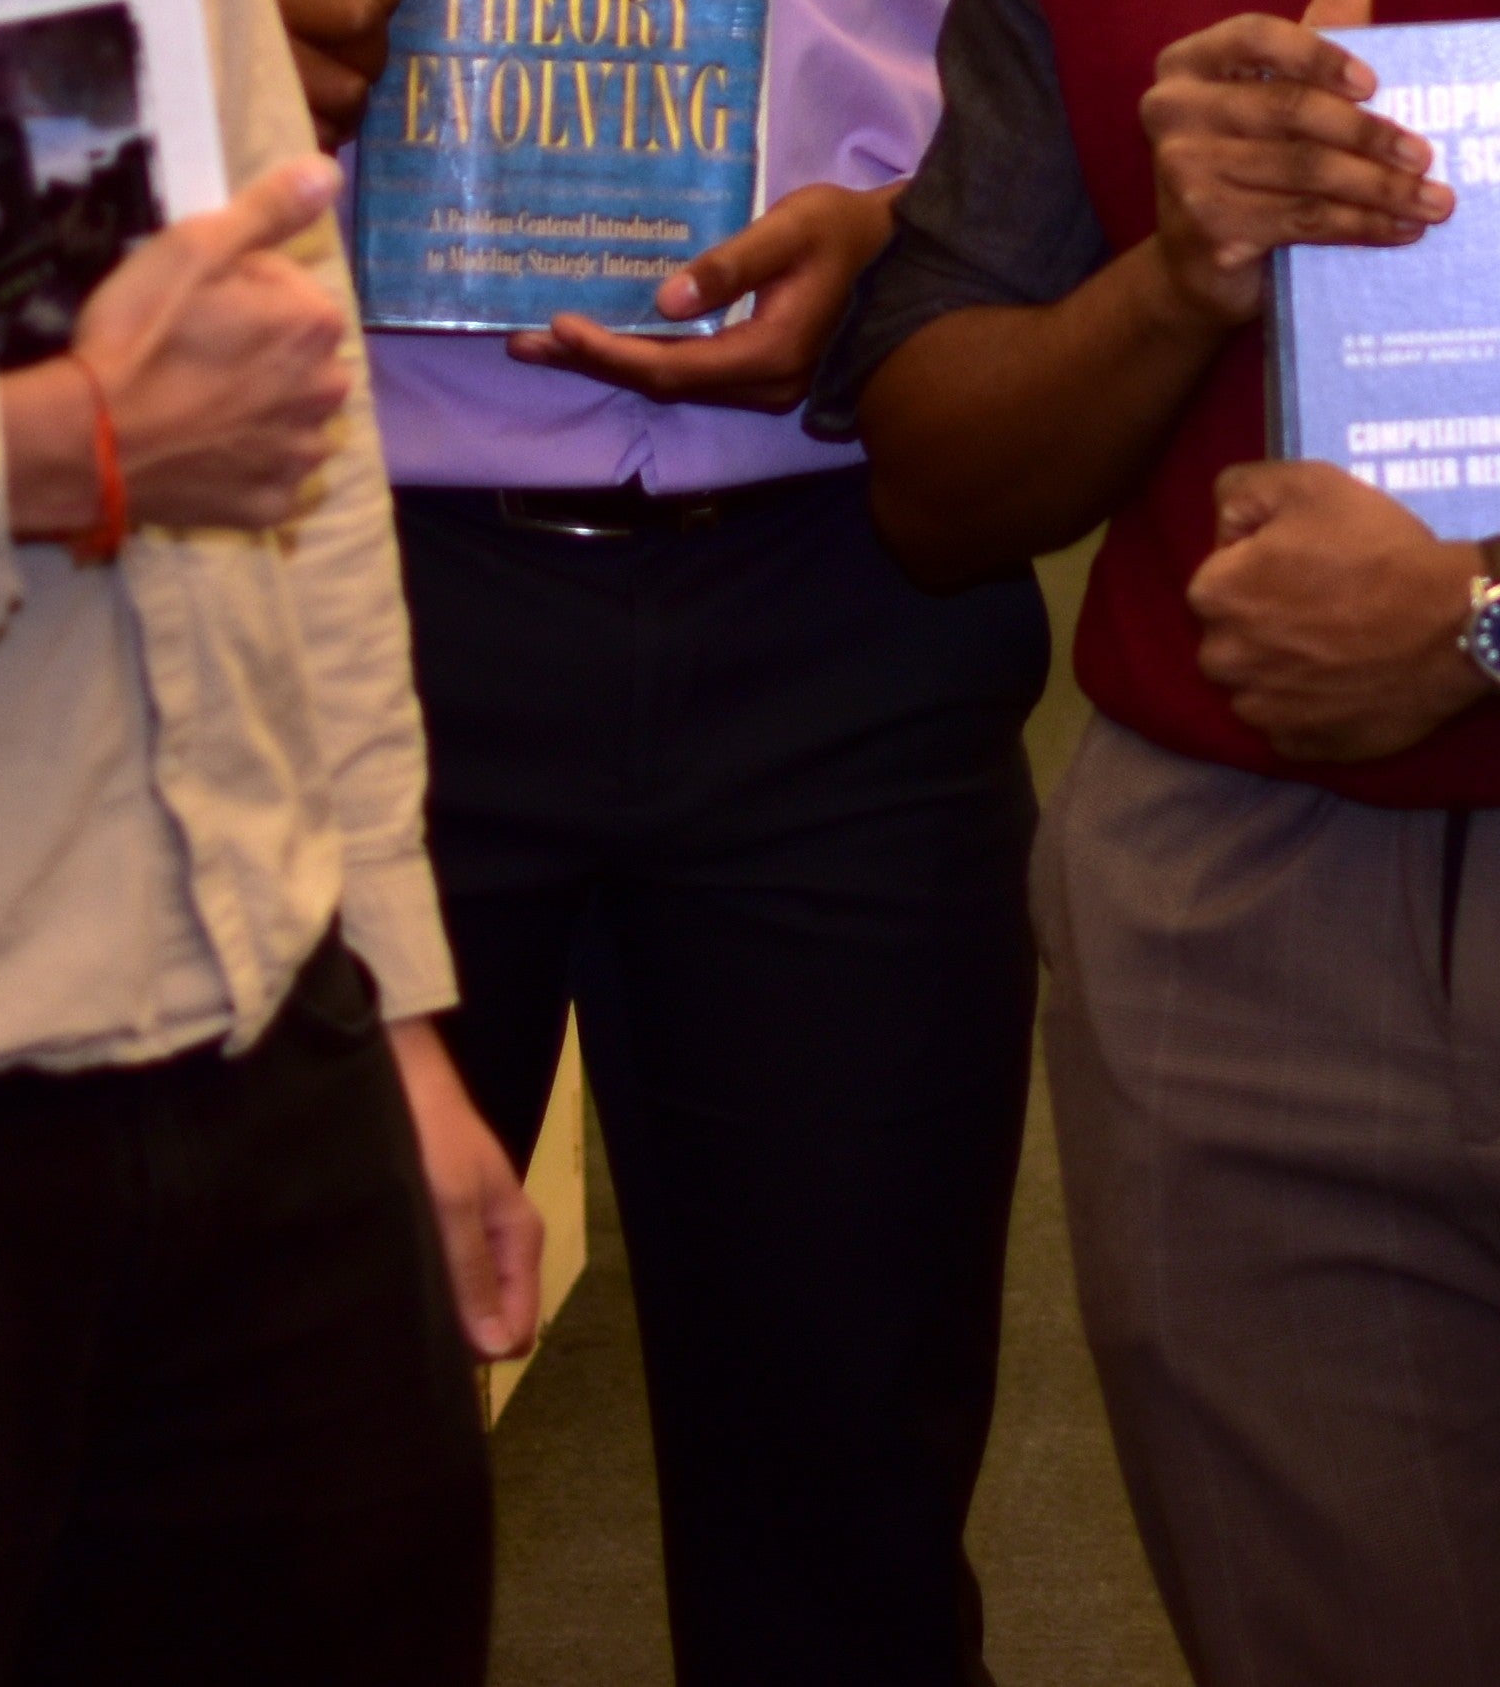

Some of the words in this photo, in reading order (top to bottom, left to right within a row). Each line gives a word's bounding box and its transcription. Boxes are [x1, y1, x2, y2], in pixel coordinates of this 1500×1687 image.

[405, 54, 730, 155] EVOLVING
[429, 208, 442, 234] A
[590, 213, 690, 242] Introduction
[526, 248, 598, 281] Strategic
[1384, 457, 1459, 491] WATER
